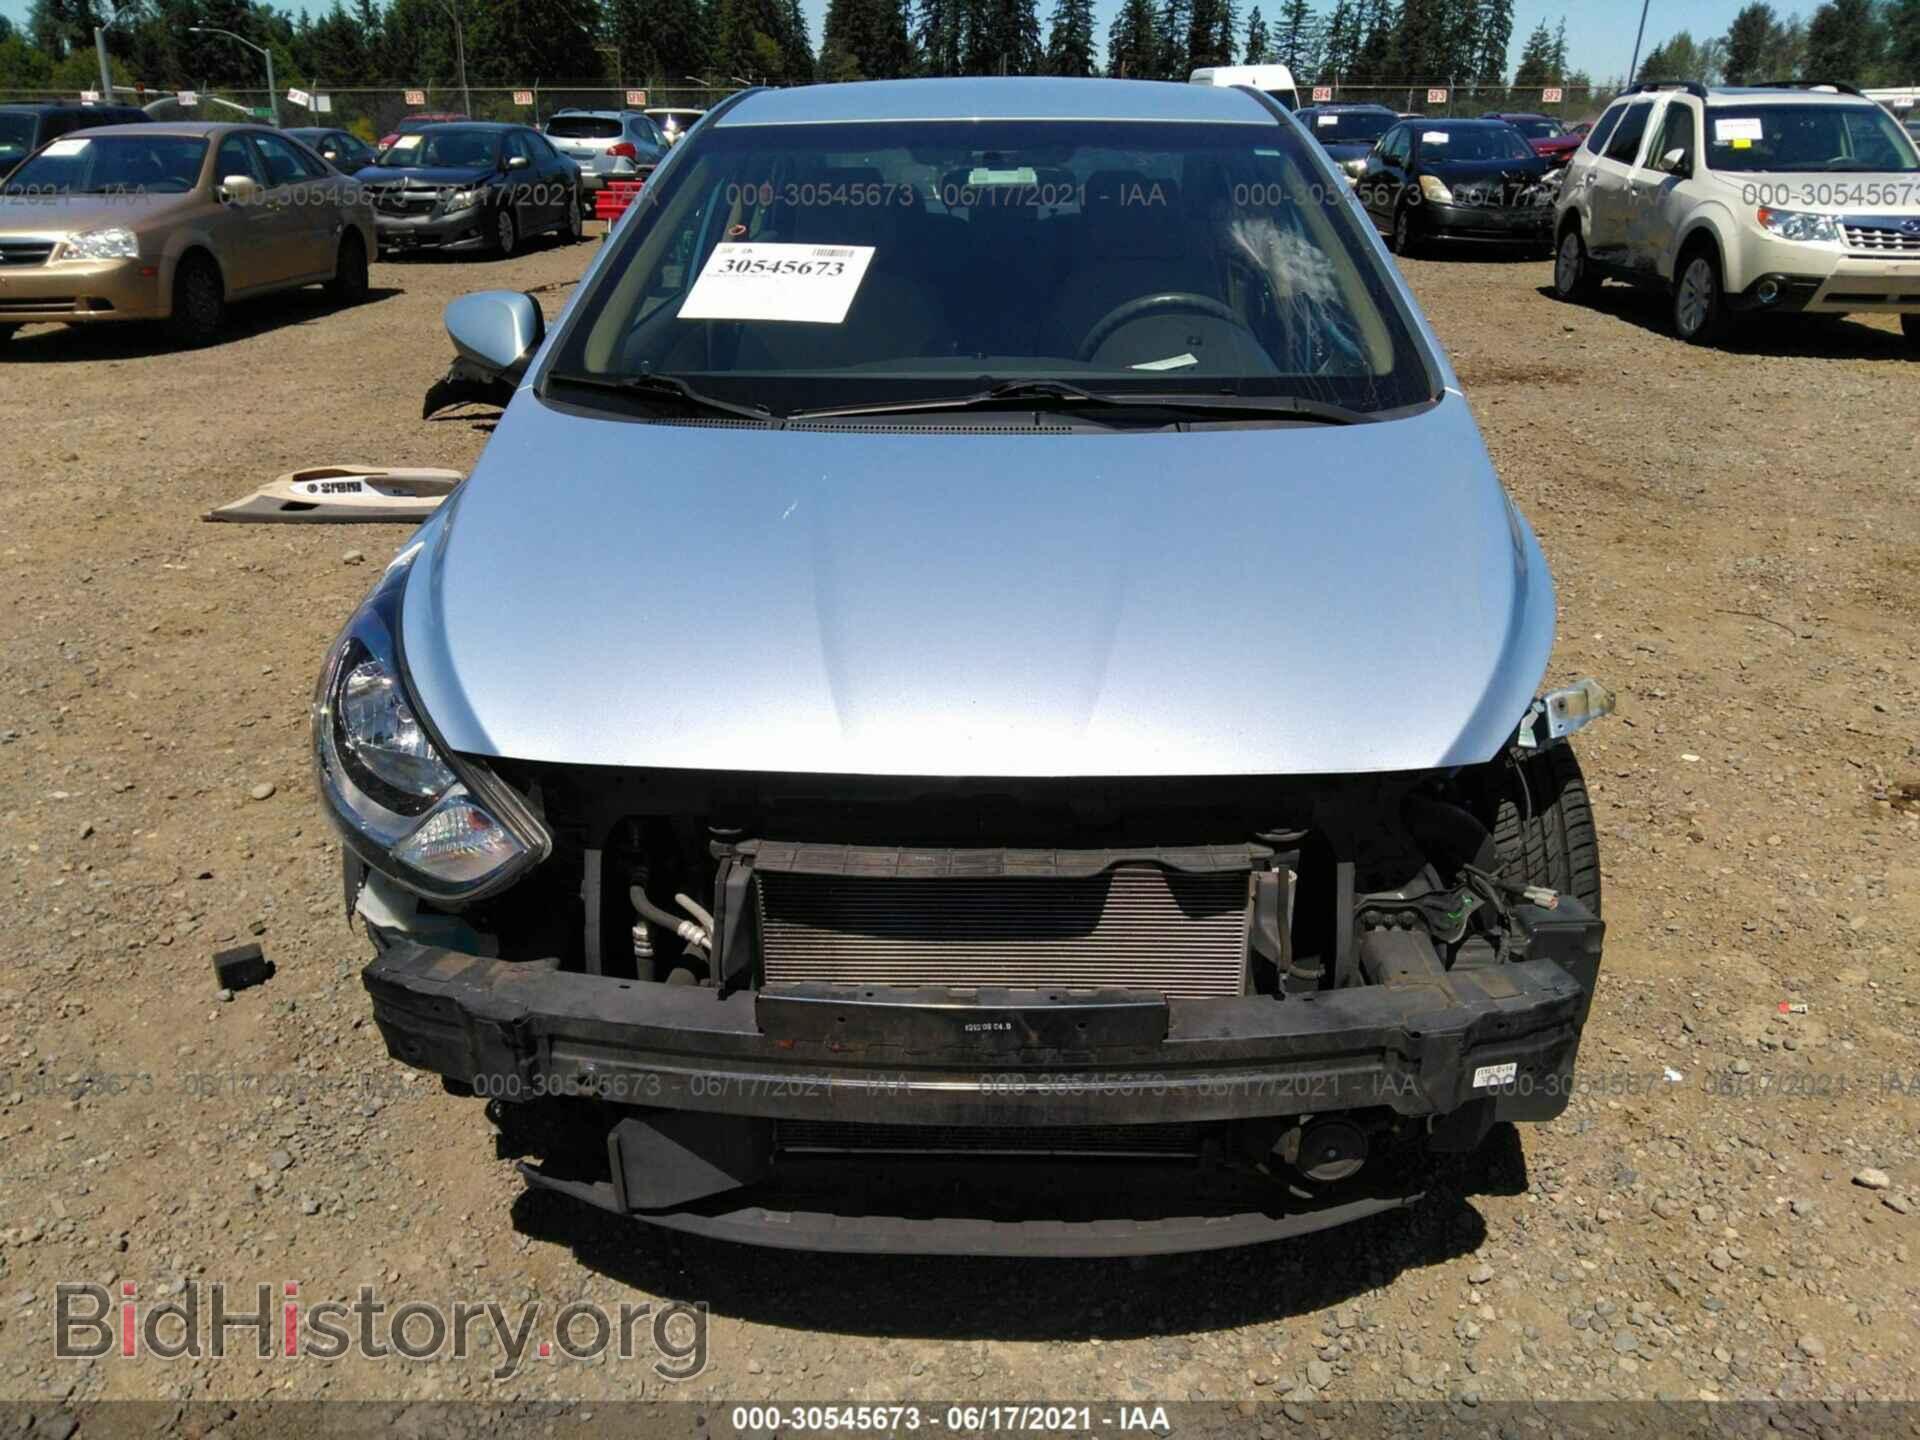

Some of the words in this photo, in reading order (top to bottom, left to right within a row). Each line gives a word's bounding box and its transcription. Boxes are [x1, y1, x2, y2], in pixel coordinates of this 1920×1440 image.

[1314, 89, 1329, 99] SF4
[1430, 90, 1445, 101] SF3
[1544, 90, 1560, 100] SF2
[718, 259, 845, 276] 30545673
